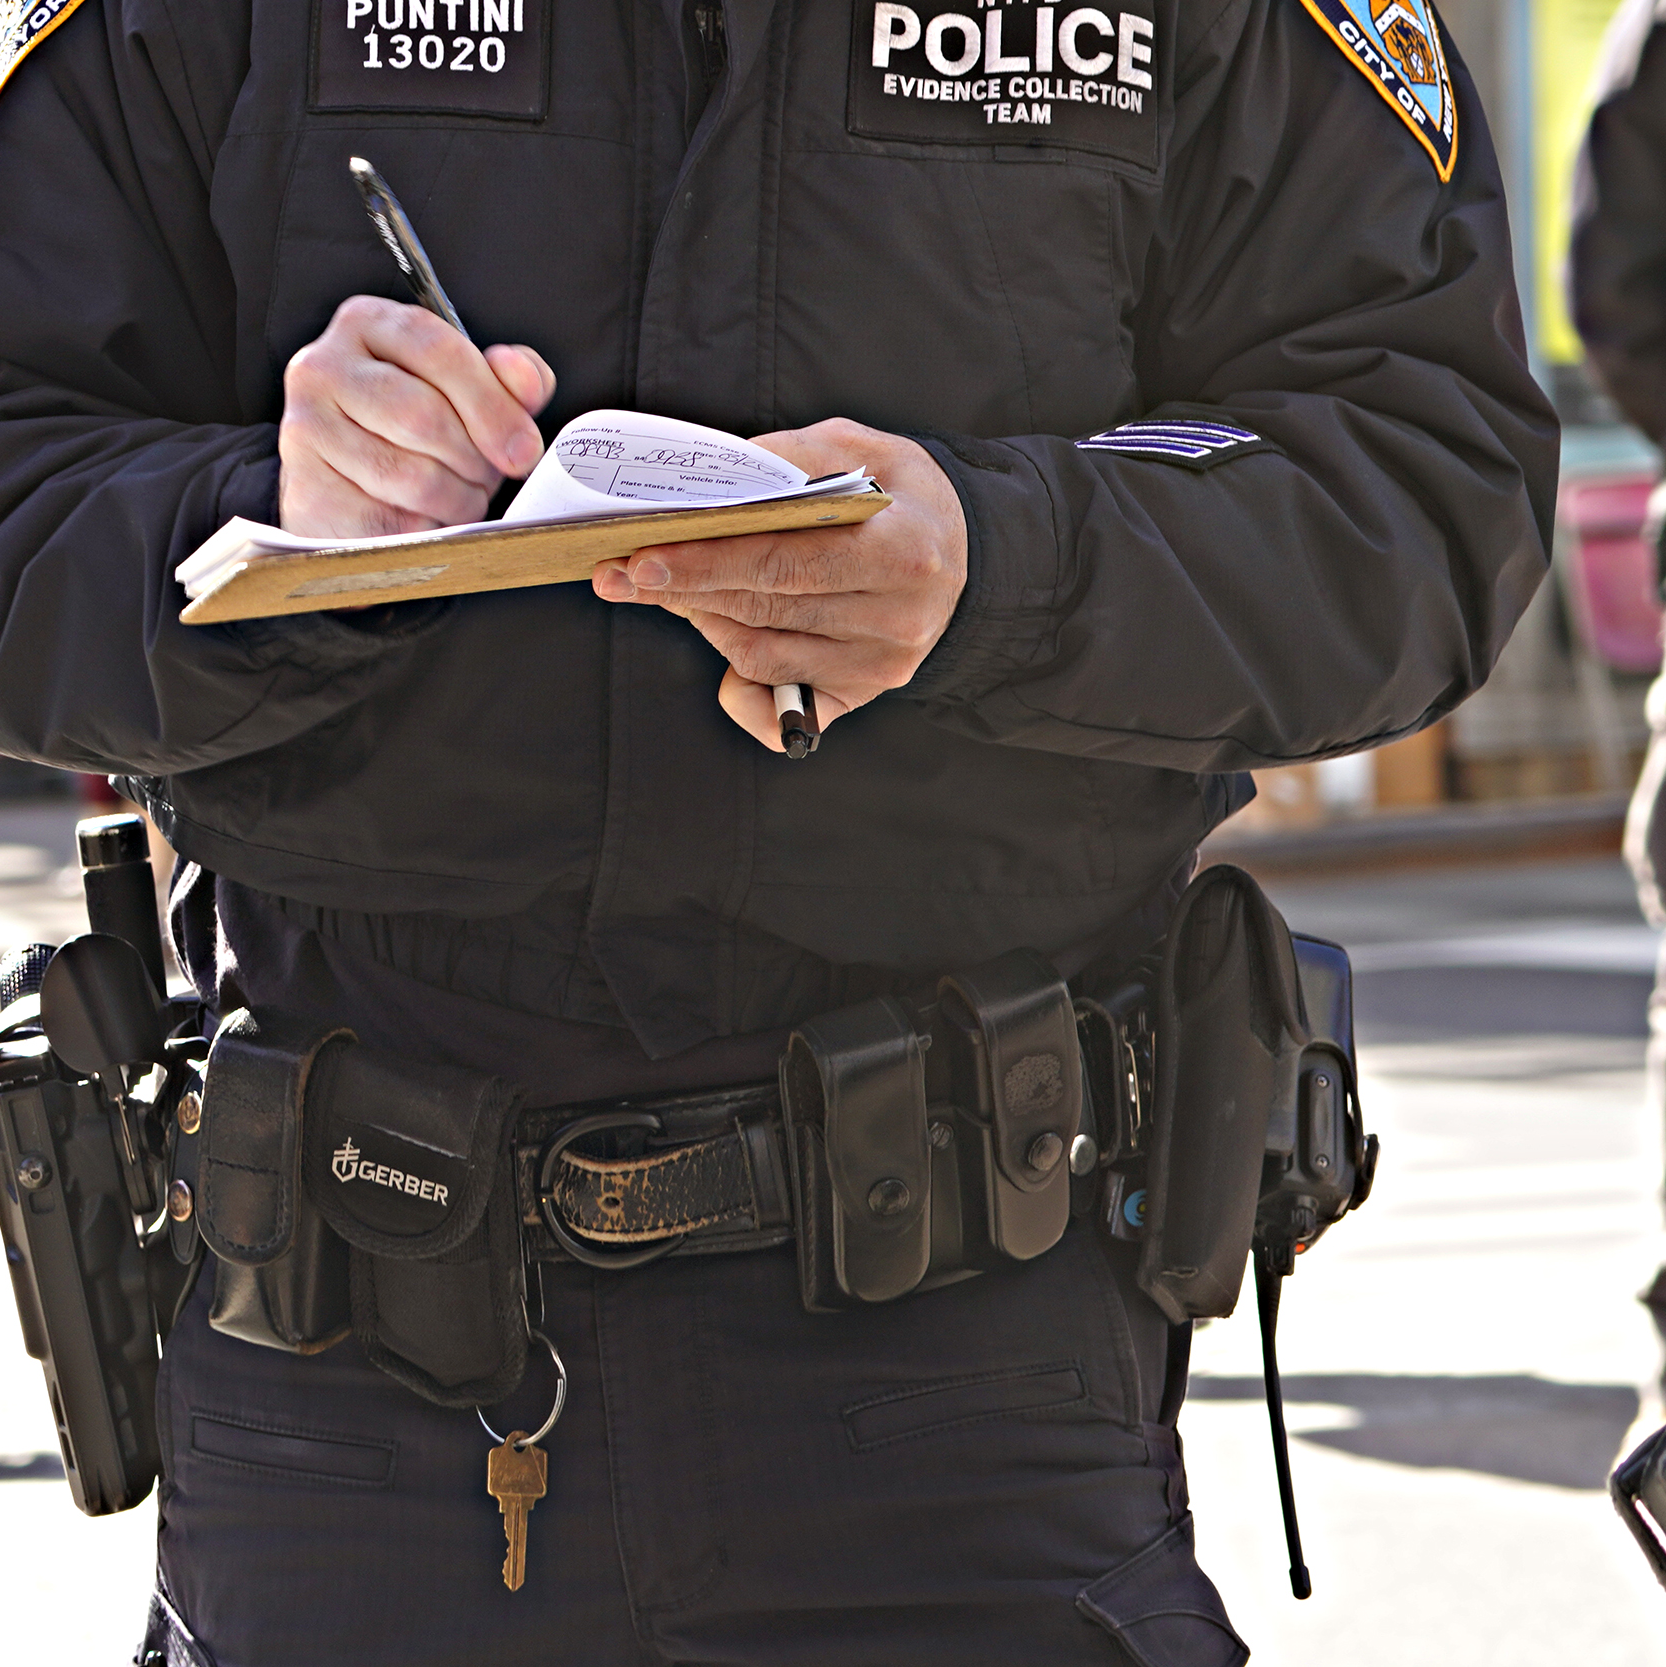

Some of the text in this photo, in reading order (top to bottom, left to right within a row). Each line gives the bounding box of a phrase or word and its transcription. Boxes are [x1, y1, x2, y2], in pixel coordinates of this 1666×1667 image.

[363, 33, 506, 73] 13020
[871, 2, 1154, 91] POLICE
[1338, 20, 1426, 125] CITY OF
[883, 73, 1143, 114] EVIDENCE COLLECTION
[983, 102, 1052, 124] TEAM
[679, 474, 714, 483] Vehicle
[358, 1160, 449, 1207] GERBER
